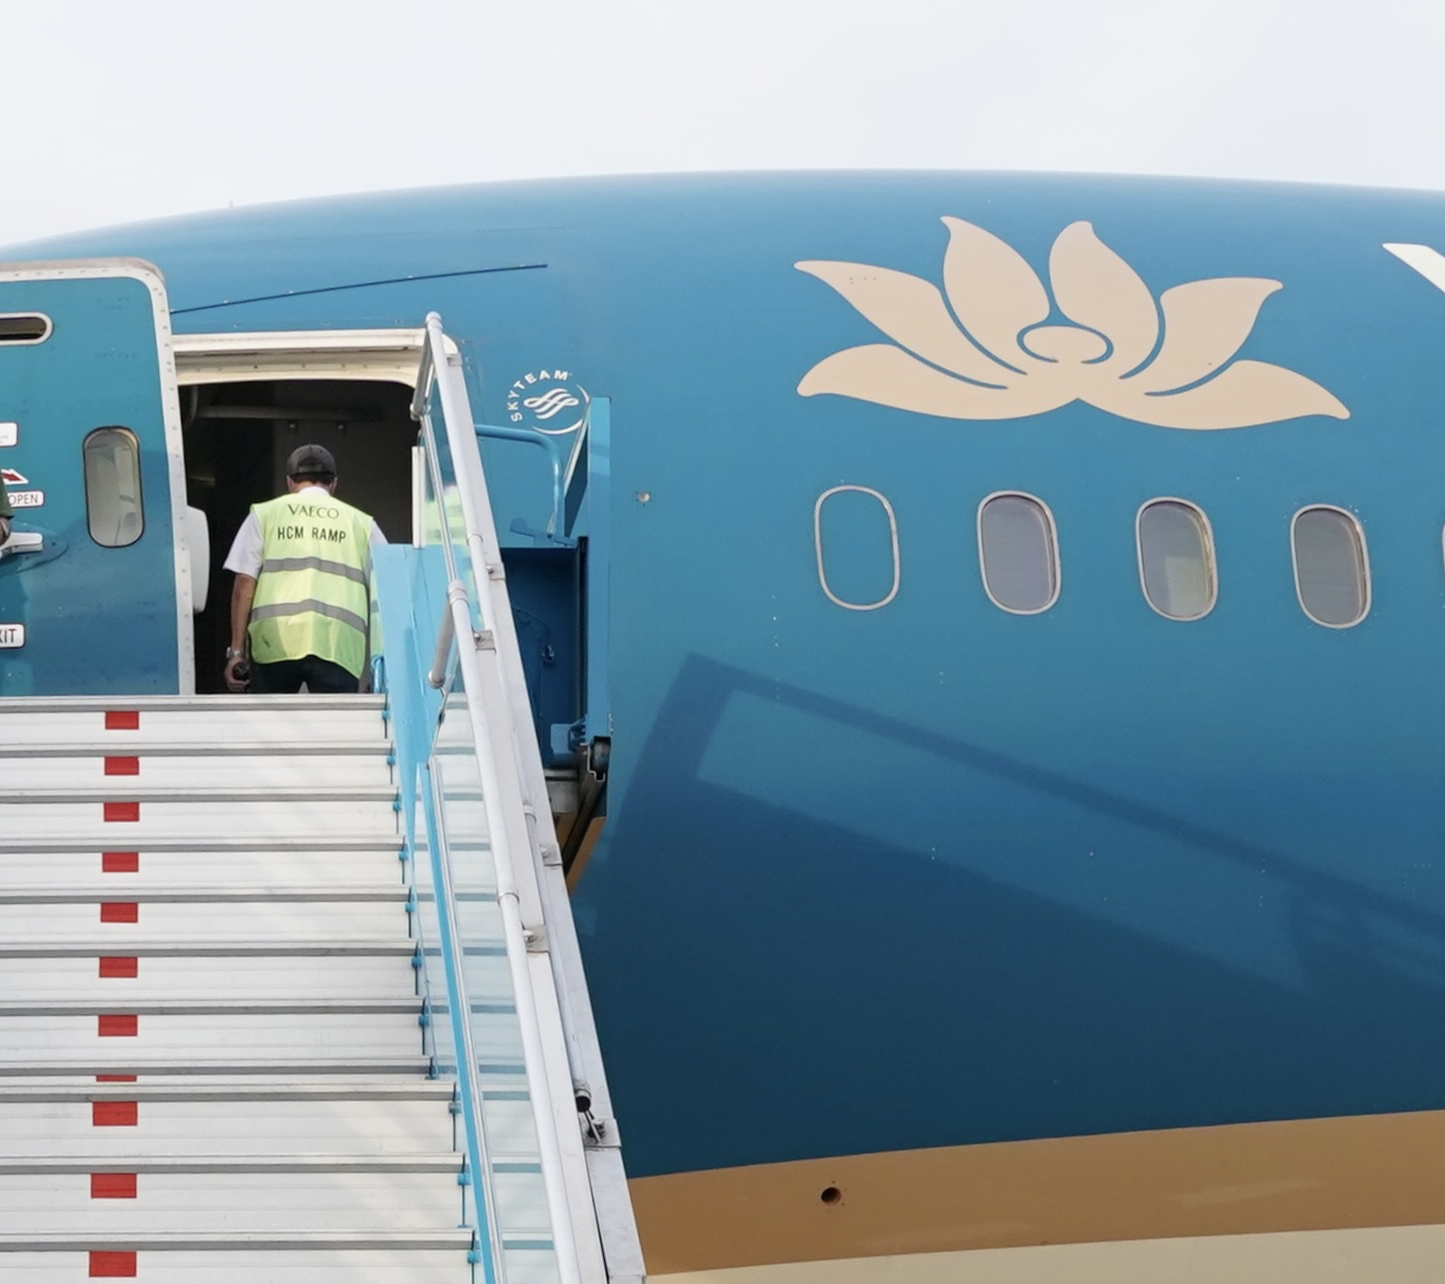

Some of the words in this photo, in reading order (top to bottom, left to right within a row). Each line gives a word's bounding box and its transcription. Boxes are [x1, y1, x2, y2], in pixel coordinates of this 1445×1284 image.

[507, 369, 569, 422] SKYTEAM
[288, 504, 339, 519] VAECO
[278, 526, 304, 540] HCM
[312, 527, 346, 543] RAMP
